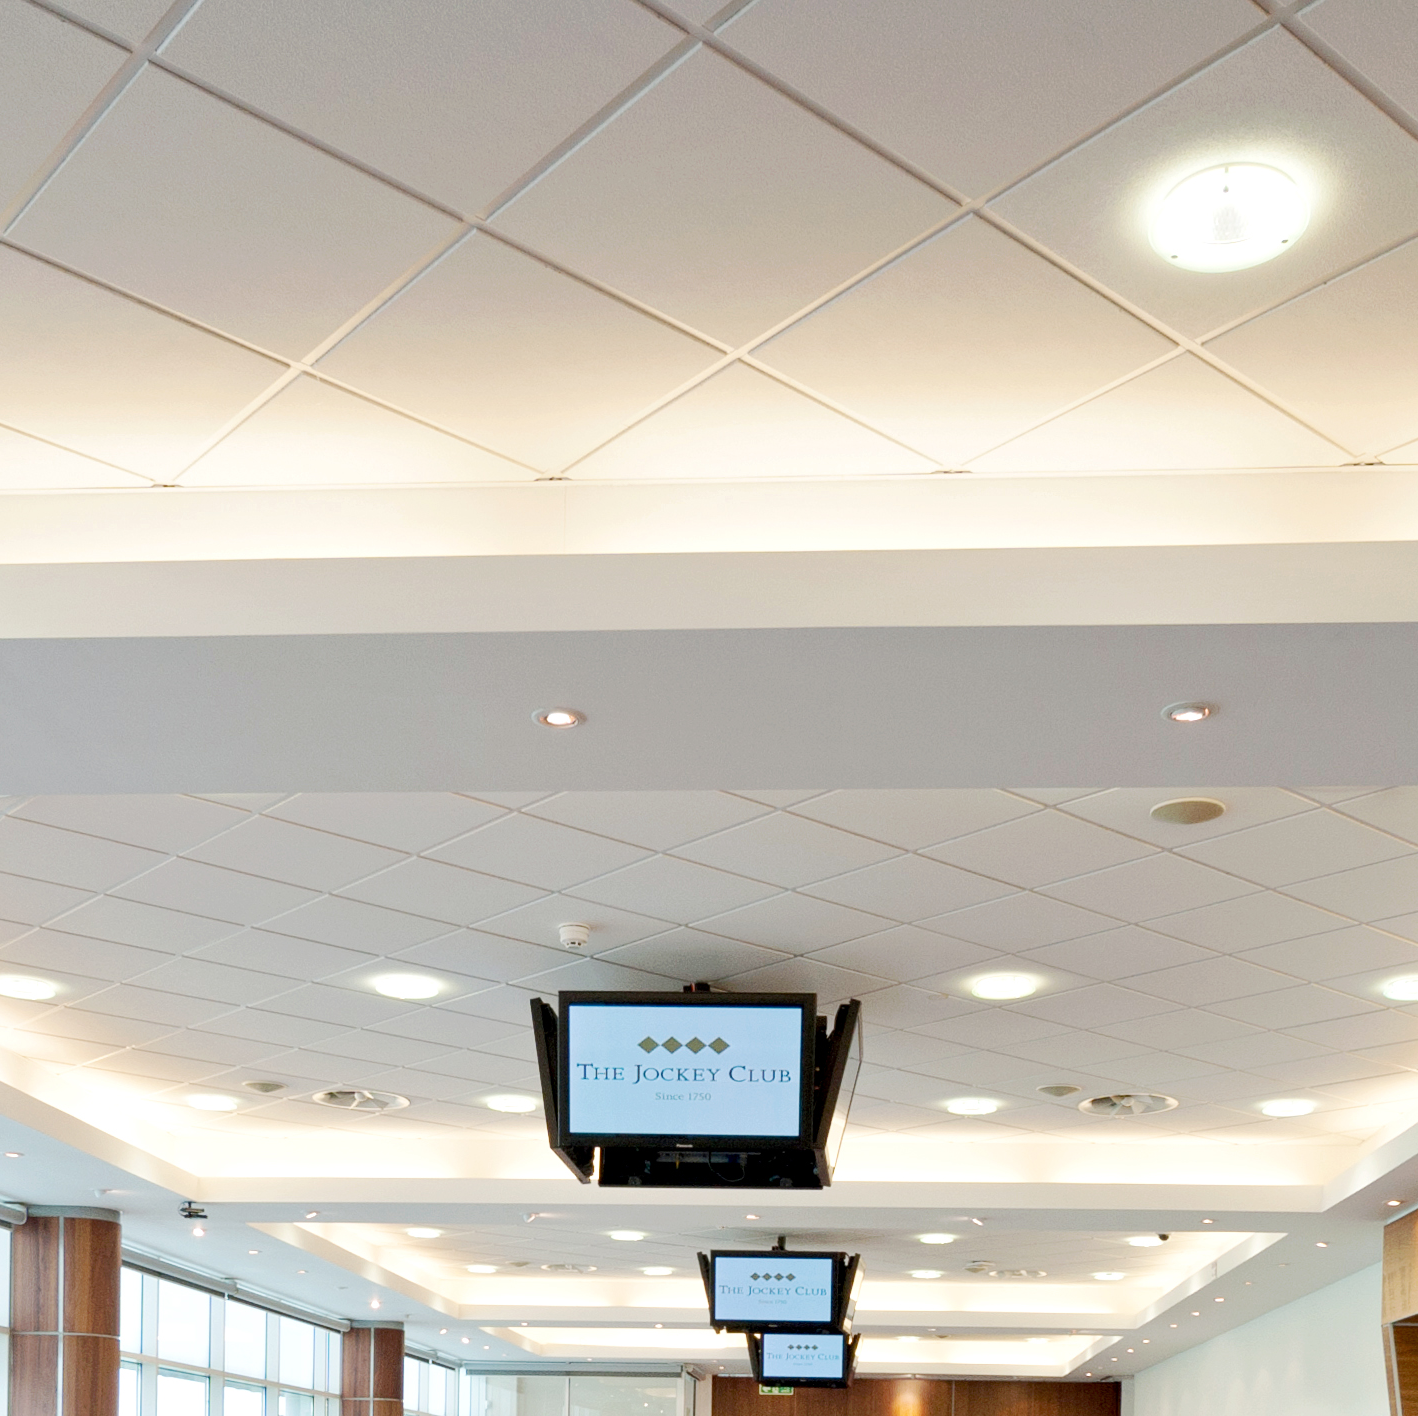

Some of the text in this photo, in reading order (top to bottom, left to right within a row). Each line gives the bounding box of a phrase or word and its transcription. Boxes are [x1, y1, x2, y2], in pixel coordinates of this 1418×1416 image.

[576, 1063, 792, 1085] THE JOCKEY CLUB
[654, 1091, 712, 1101] Since 1750
[719, 1285, 828, 1297] THE JOCKEY CLUB
[785, 1352, 815, 1361] JOCKEY
